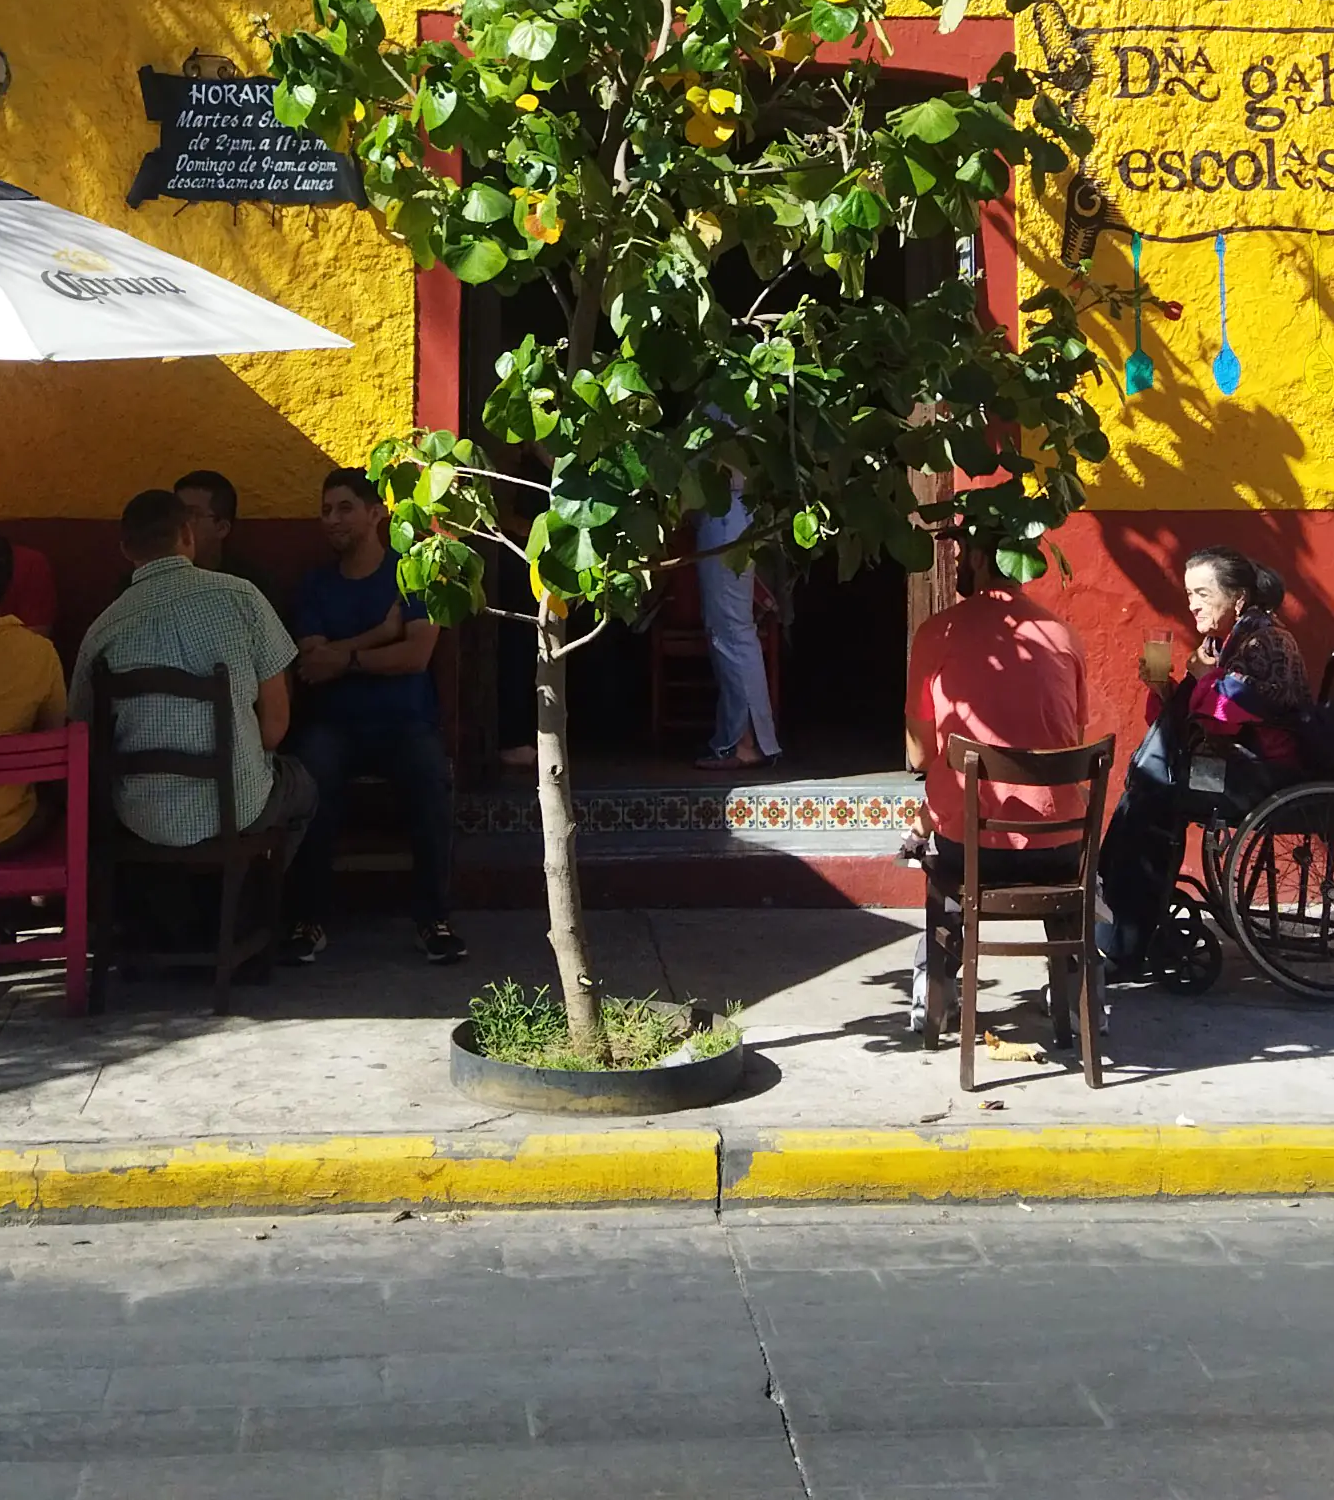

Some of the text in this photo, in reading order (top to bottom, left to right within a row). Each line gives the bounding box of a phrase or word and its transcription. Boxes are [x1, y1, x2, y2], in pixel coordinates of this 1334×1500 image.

[188, 83, 278, 106] HORAR
[176, 110, 238, 128] Martes
[242, 117, 253, 128] a
[188, 132, 210, 150] de
[259, 138, 271, 150] a
[176, 154, 235, 176] Domingo
[239, 154, 257, 173] de
[167, 174, 334, 191] descansamos los Lunes
[41, 270, 186, 304] Corona
